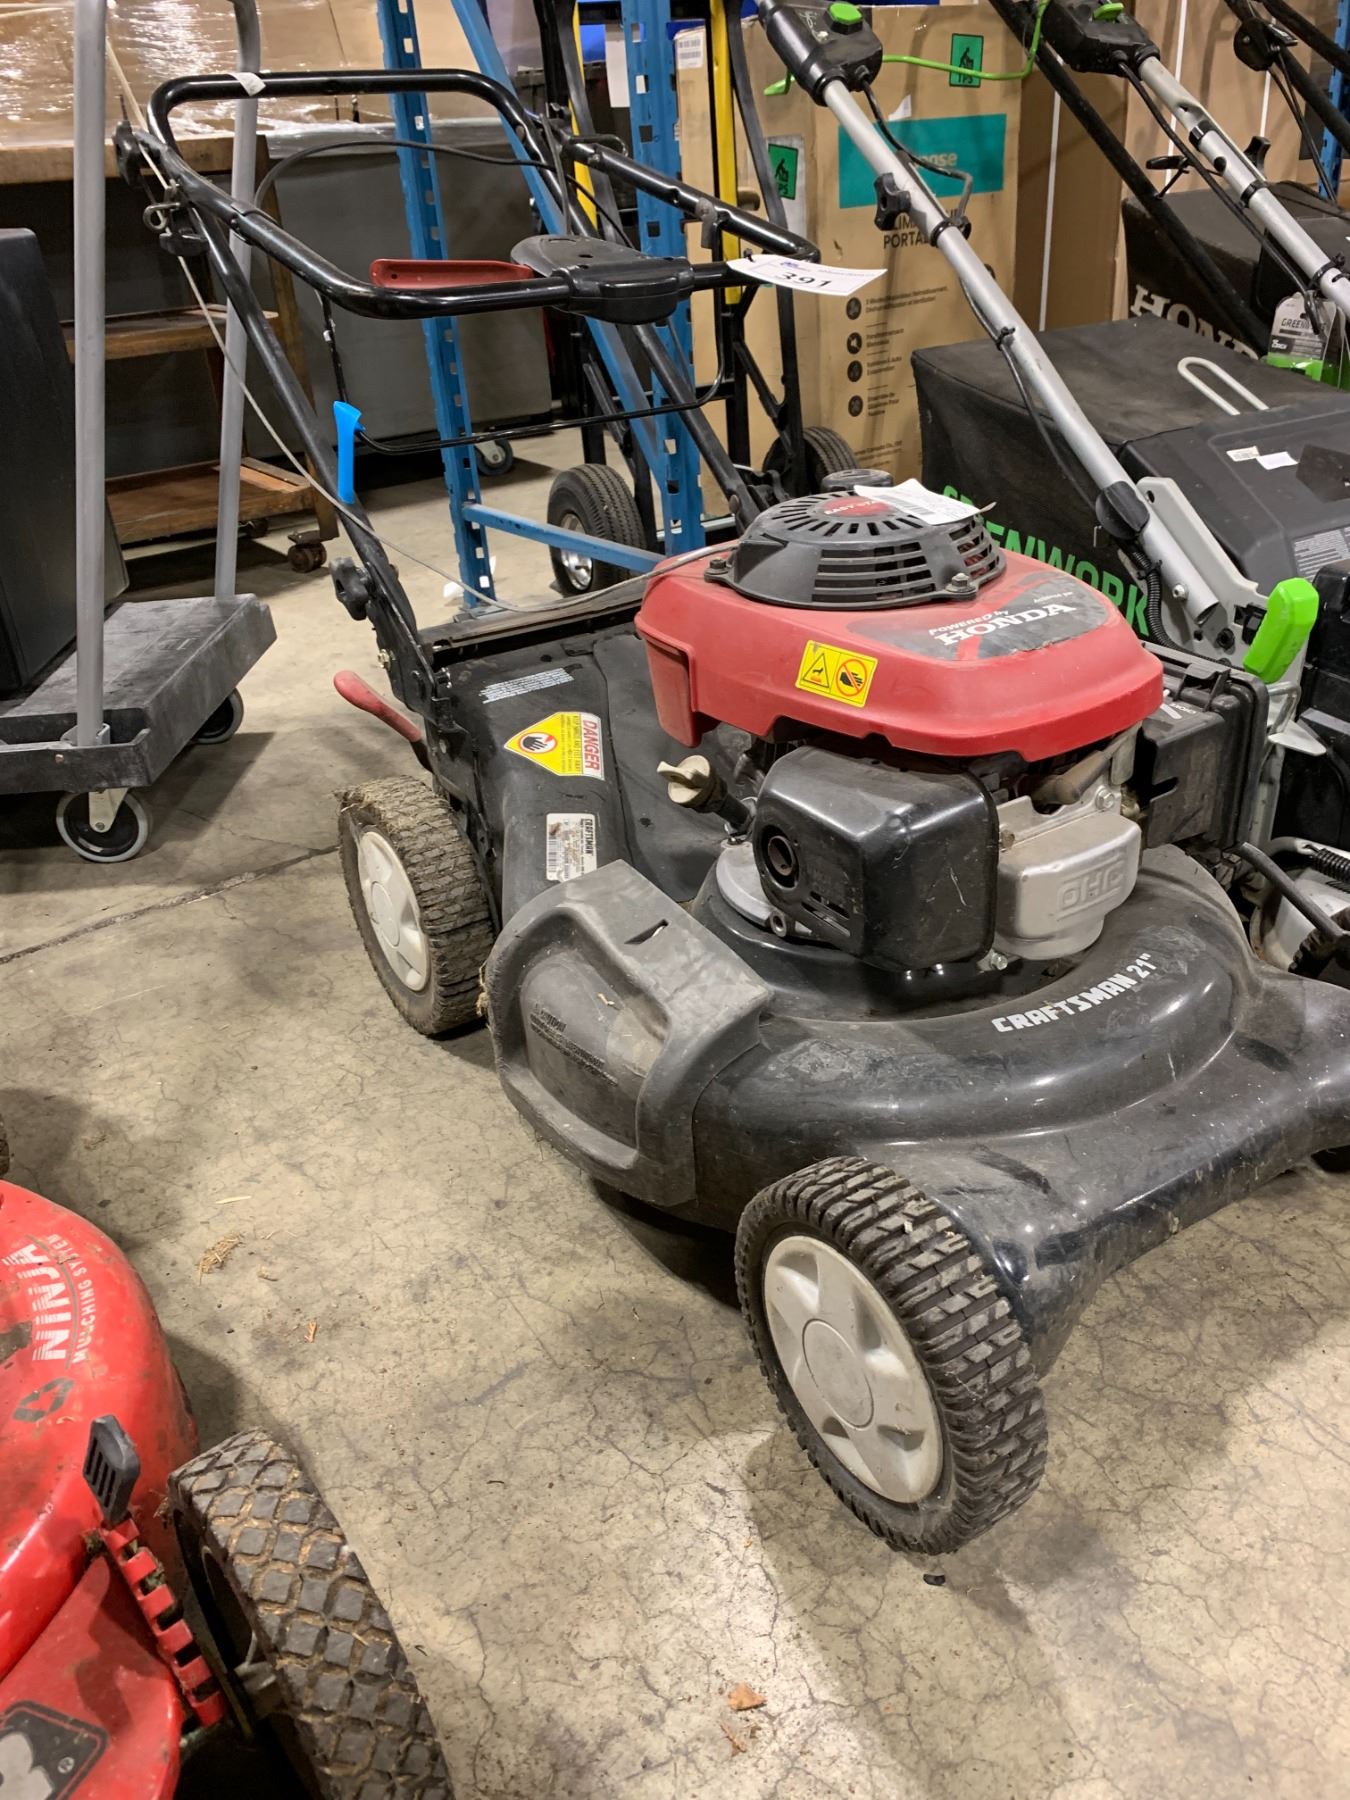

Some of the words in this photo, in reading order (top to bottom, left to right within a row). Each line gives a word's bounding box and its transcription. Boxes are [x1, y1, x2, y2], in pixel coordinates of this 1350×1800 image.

[775, 272, 832, 288] 391
[928, 613, 993, 636] POWERED
[993, 610, 1009, 618] by
[934, 604, 1077, 646] HONDA
[583, 719, 600, 770] DANGER
[584, 818, 594, 855] CRAFTSMAN
[1058, 860, 1125, 911] OHC
[991, 973, 1138, 1033] CRAFTSMAN
[1126, 952, 1157, 979] 21"
[1, 1243, 72, 1361] NINJA
